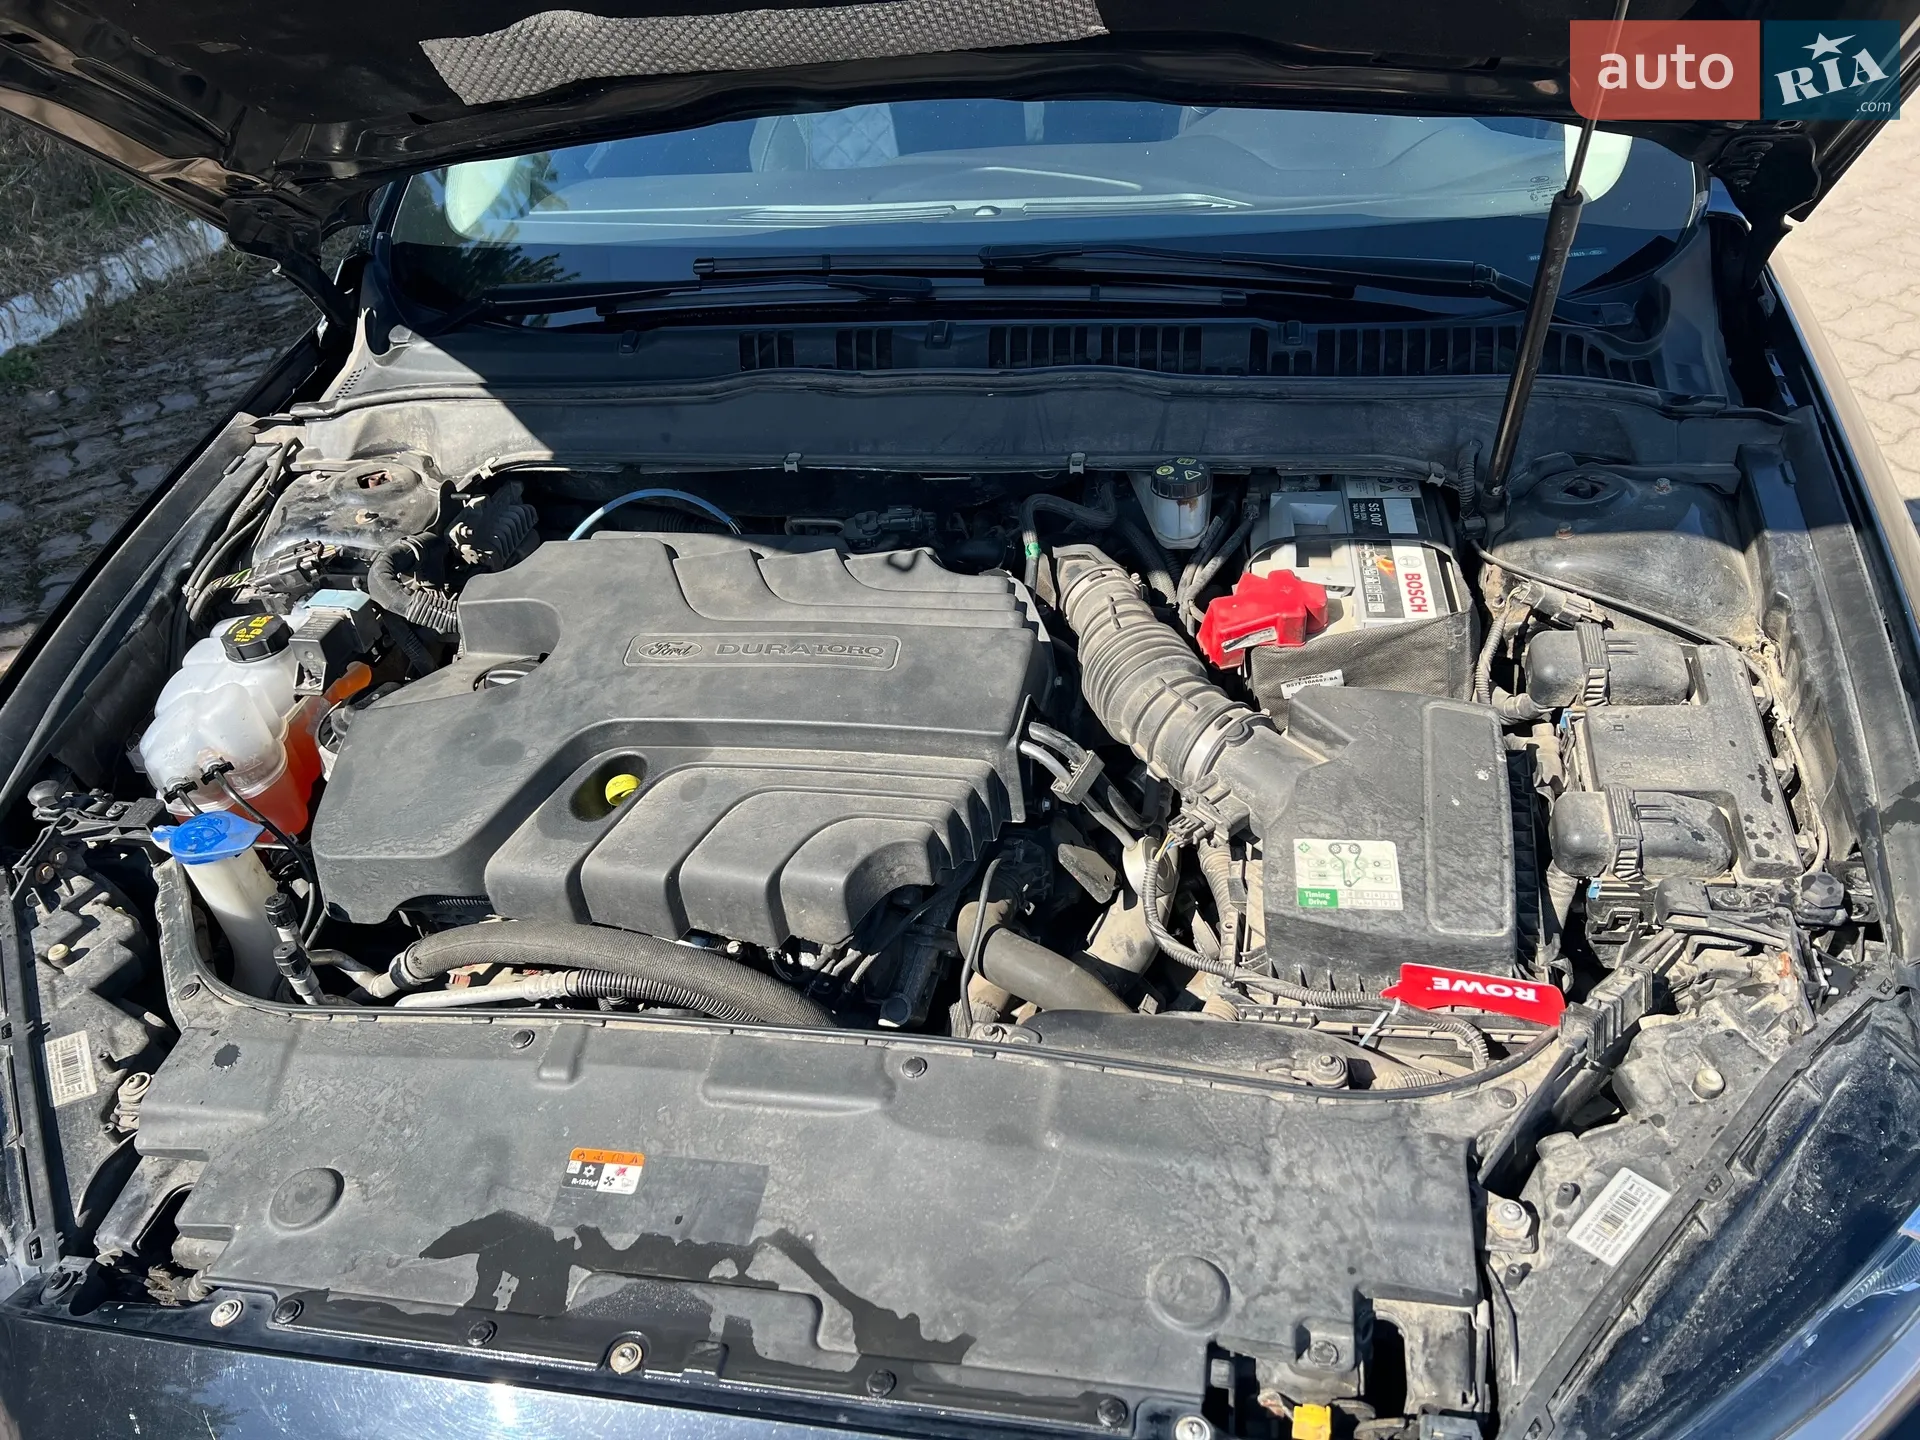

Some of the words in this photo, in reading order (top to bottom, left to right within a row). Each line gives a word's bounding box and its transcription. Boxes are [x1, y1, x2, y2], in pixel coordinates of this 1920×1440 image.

[1368, 502, 1380, 512] S5
[1370, 513, 1383, 527] 007
[1404, 573, 1428, 612] BOSCH
[647, 641, 693, 657] Ford
[716, 643, 884, 658] DURATORQ
[1304, 890, 1331, 899] Timing
[1308, 898, 1328, 906] Drive
[1432, 976, 1540, 1003] ROWE
